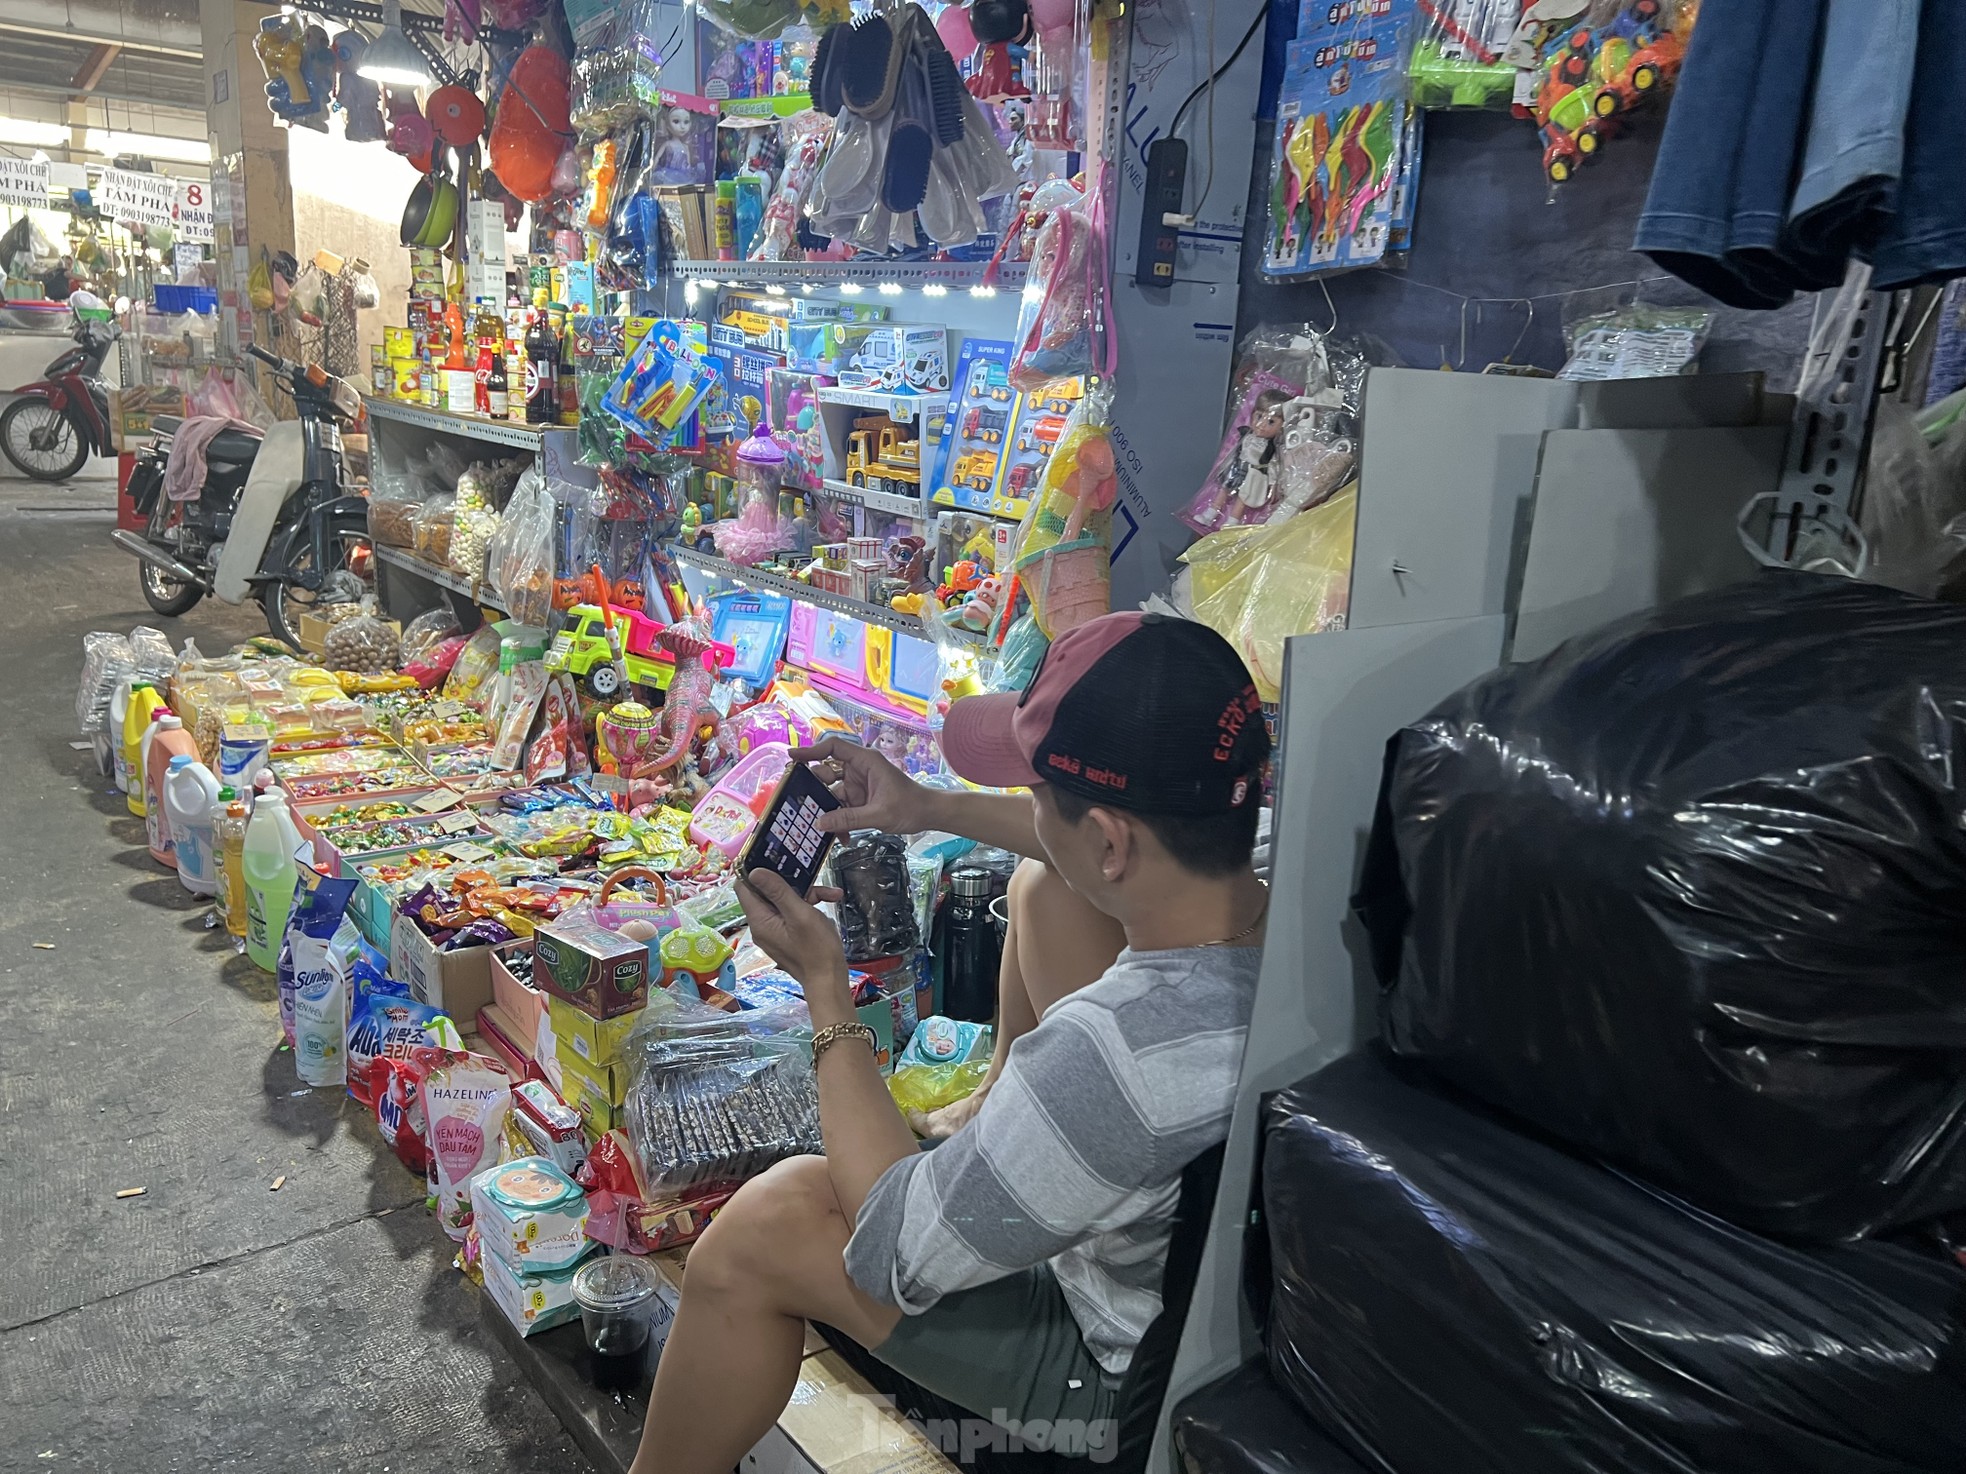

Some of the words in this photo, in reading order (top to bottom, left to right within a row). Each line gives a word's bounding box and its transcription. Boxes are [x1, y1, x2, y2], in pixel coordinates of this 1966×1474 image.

[104, 171, 126, 189] NHẬN
[186, 184, 203, 206] 8
[120, 207, 171, 228] 0903198773
[181, 208, 206, 225] NHẬN
[666, 338, 717, 382] BALLOON
[1257, 374, 1279, 390] Cute
[1126, 449, 1144, 475] ISO
[538, 943, 557, 961] Cozy
[616, 962, 639, 975] Cozy
[383, 1026, 426, 1045] 세탁조
